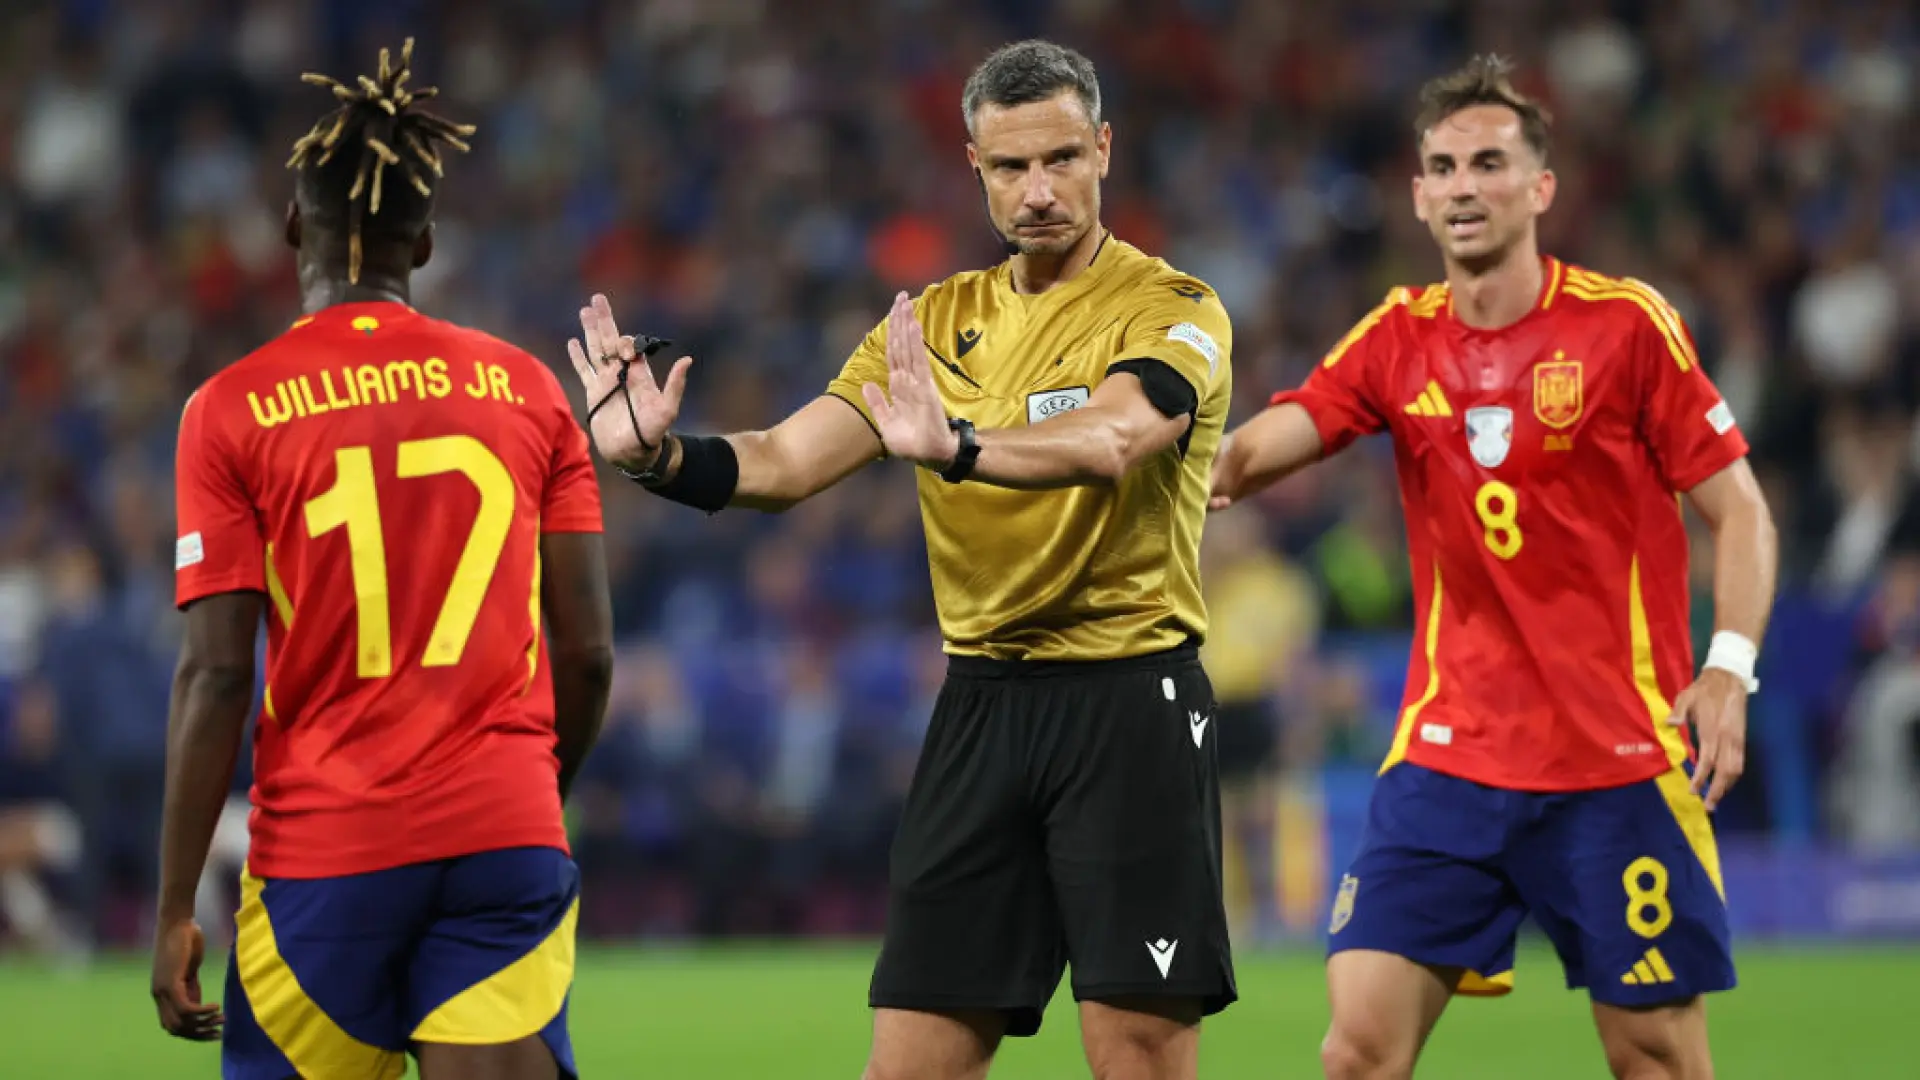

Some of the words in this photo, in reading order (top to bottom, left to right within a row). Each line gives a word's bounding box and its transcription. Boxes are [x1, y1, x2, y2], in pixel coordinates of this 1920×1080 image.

[247, 356, 453, 428] WILLIAMS
[464, 359, 526, 406] JR.
[1039, 398, 1076, 415] UEFA
[303, 434, 515, 678] 17
[1474, 480, 1524, 560] 8
[1621, 856, 1674, 939] 8
